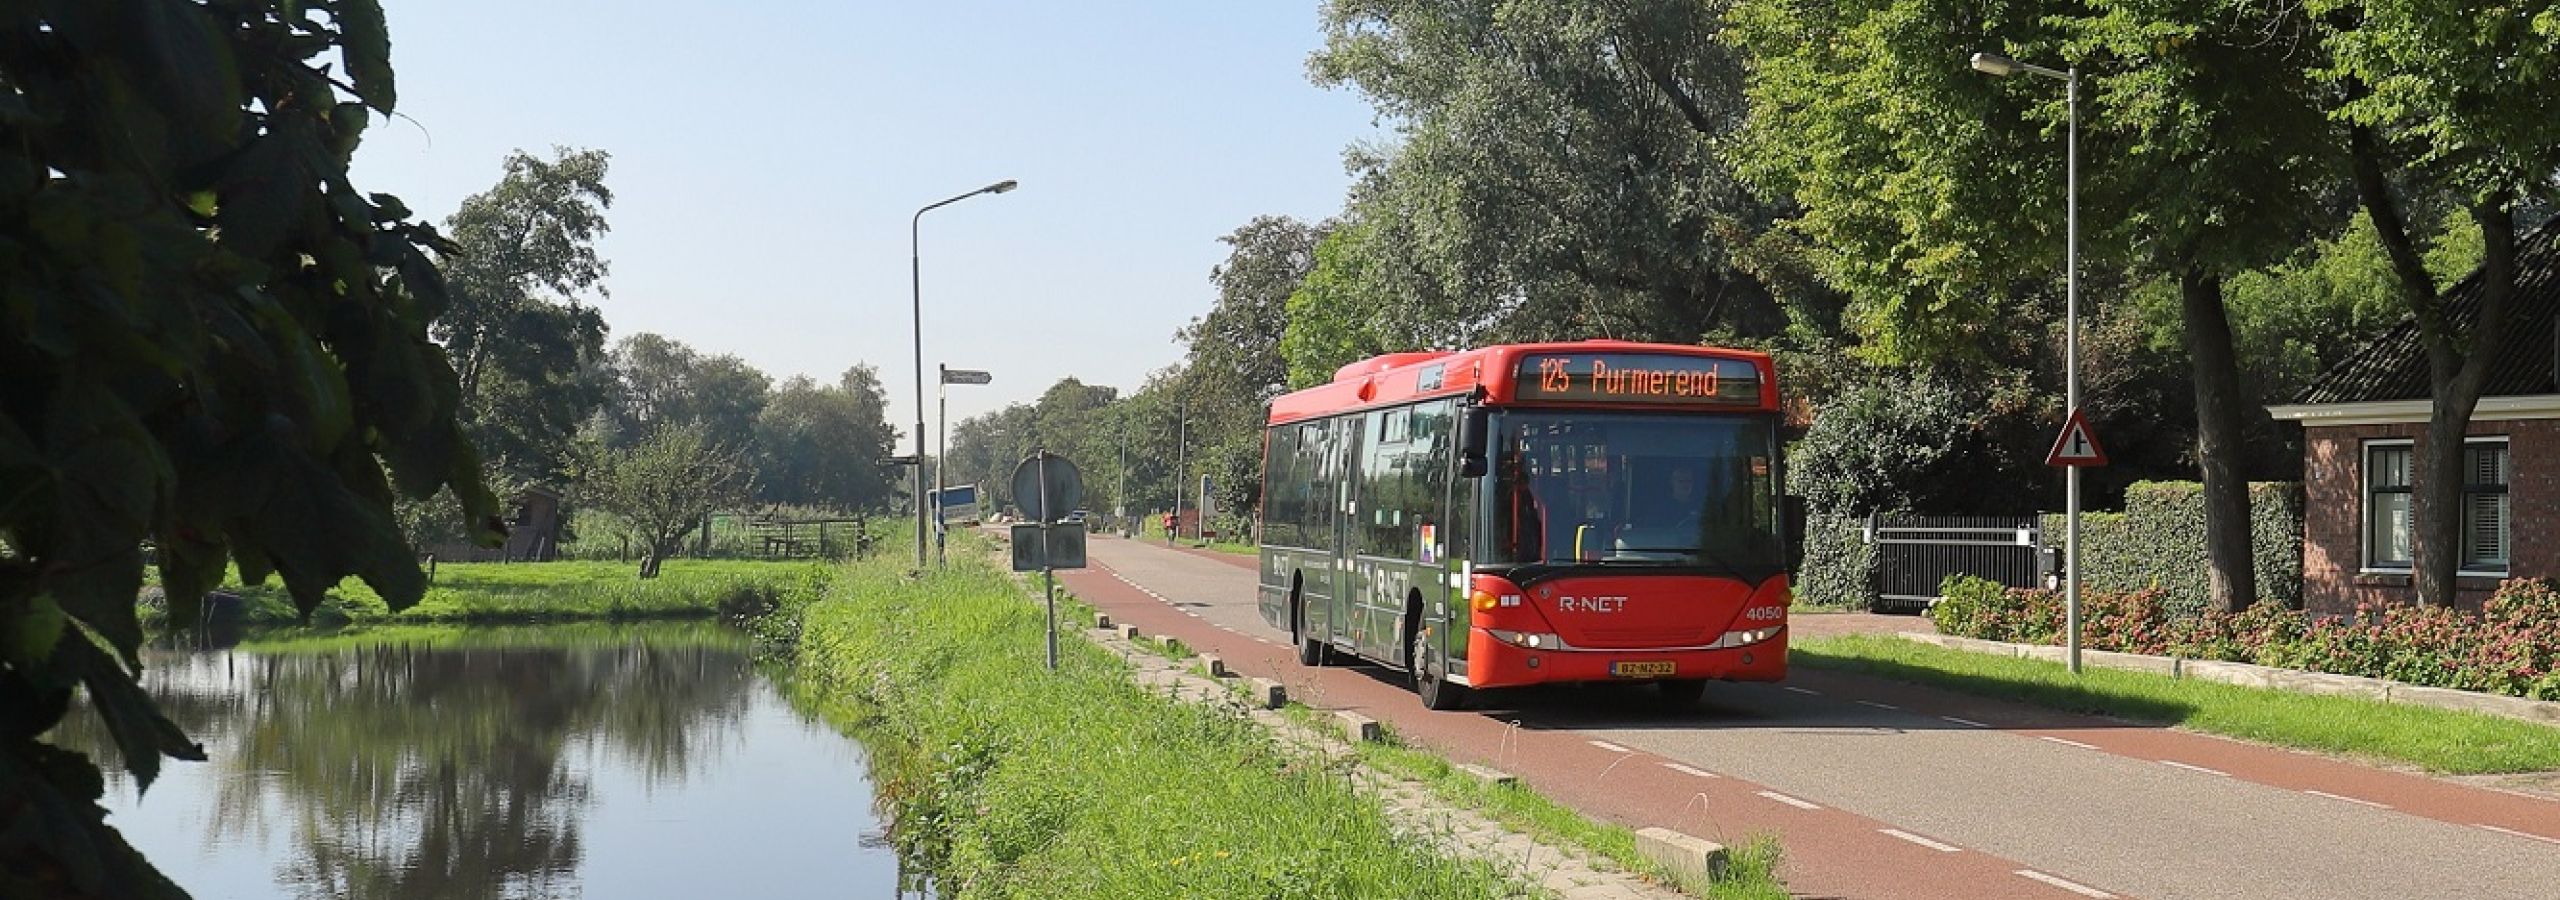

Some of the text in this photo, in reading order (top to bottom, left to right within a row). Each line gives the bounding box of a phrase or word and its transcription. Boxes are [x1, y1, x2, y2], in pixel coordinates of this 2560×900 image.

[1540, 358, 1718, 396] 125 Purmerend
[1746, 606, 1782, 620] 4050
